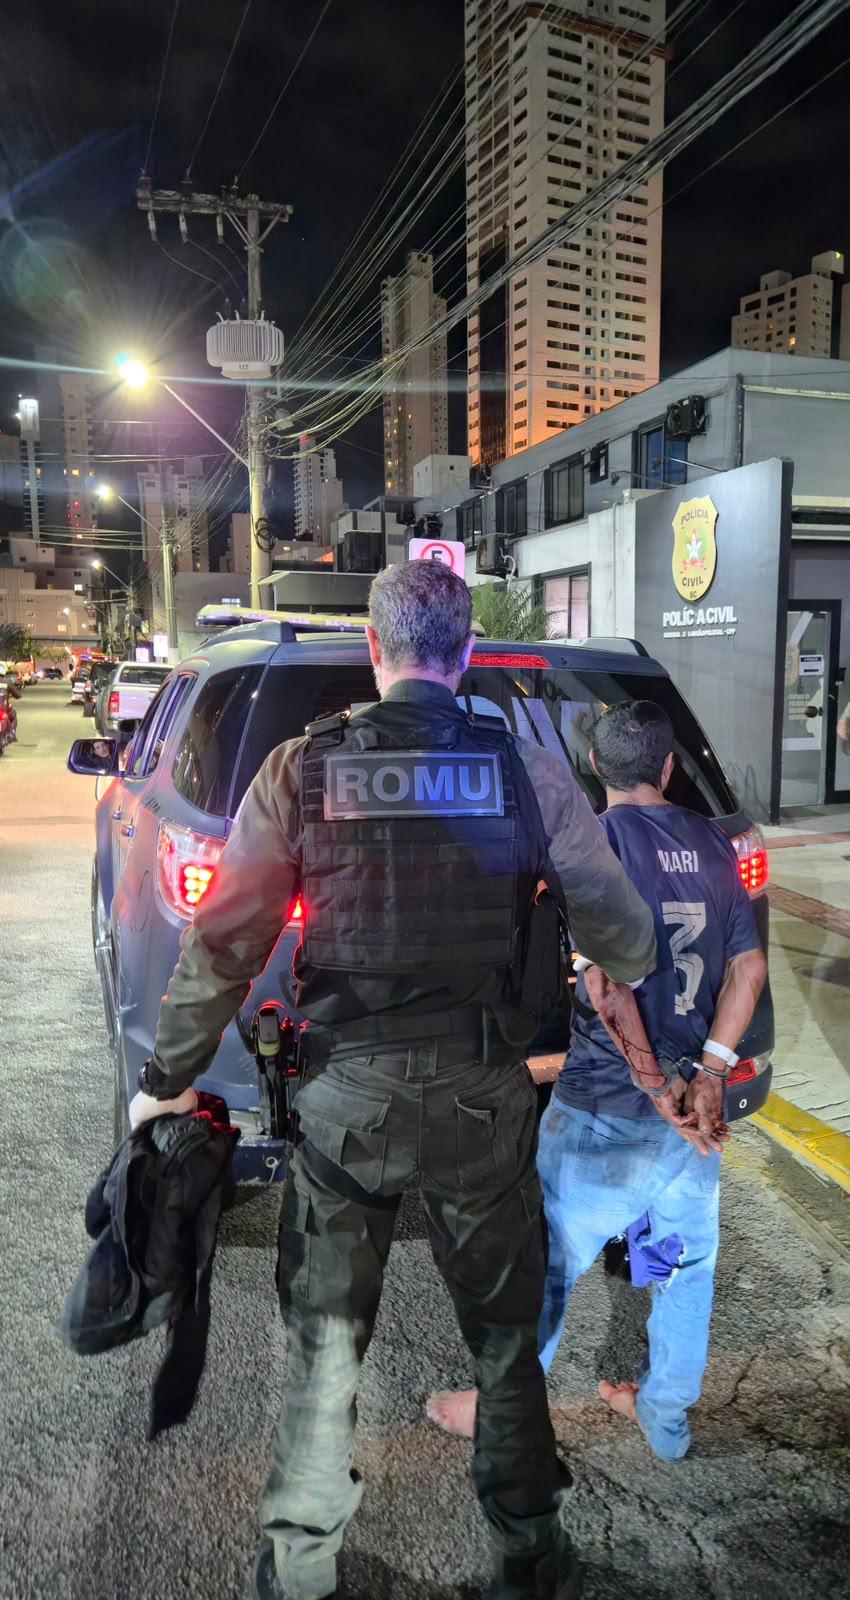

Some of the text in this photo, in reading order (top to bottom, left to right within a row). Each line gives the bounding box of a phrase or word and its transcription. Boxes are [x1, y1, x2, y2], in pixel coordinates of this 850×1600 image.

[681, 575, 704, 588] CIVIL
[689, 590, 697, 599] SC
[663, 606, 738, 627] POLÍCA CIVIL
[336, 765, 491, 803] ROMU
[657, 849, 699, 874] MARI
[661, 901, 707, 1016] 3
